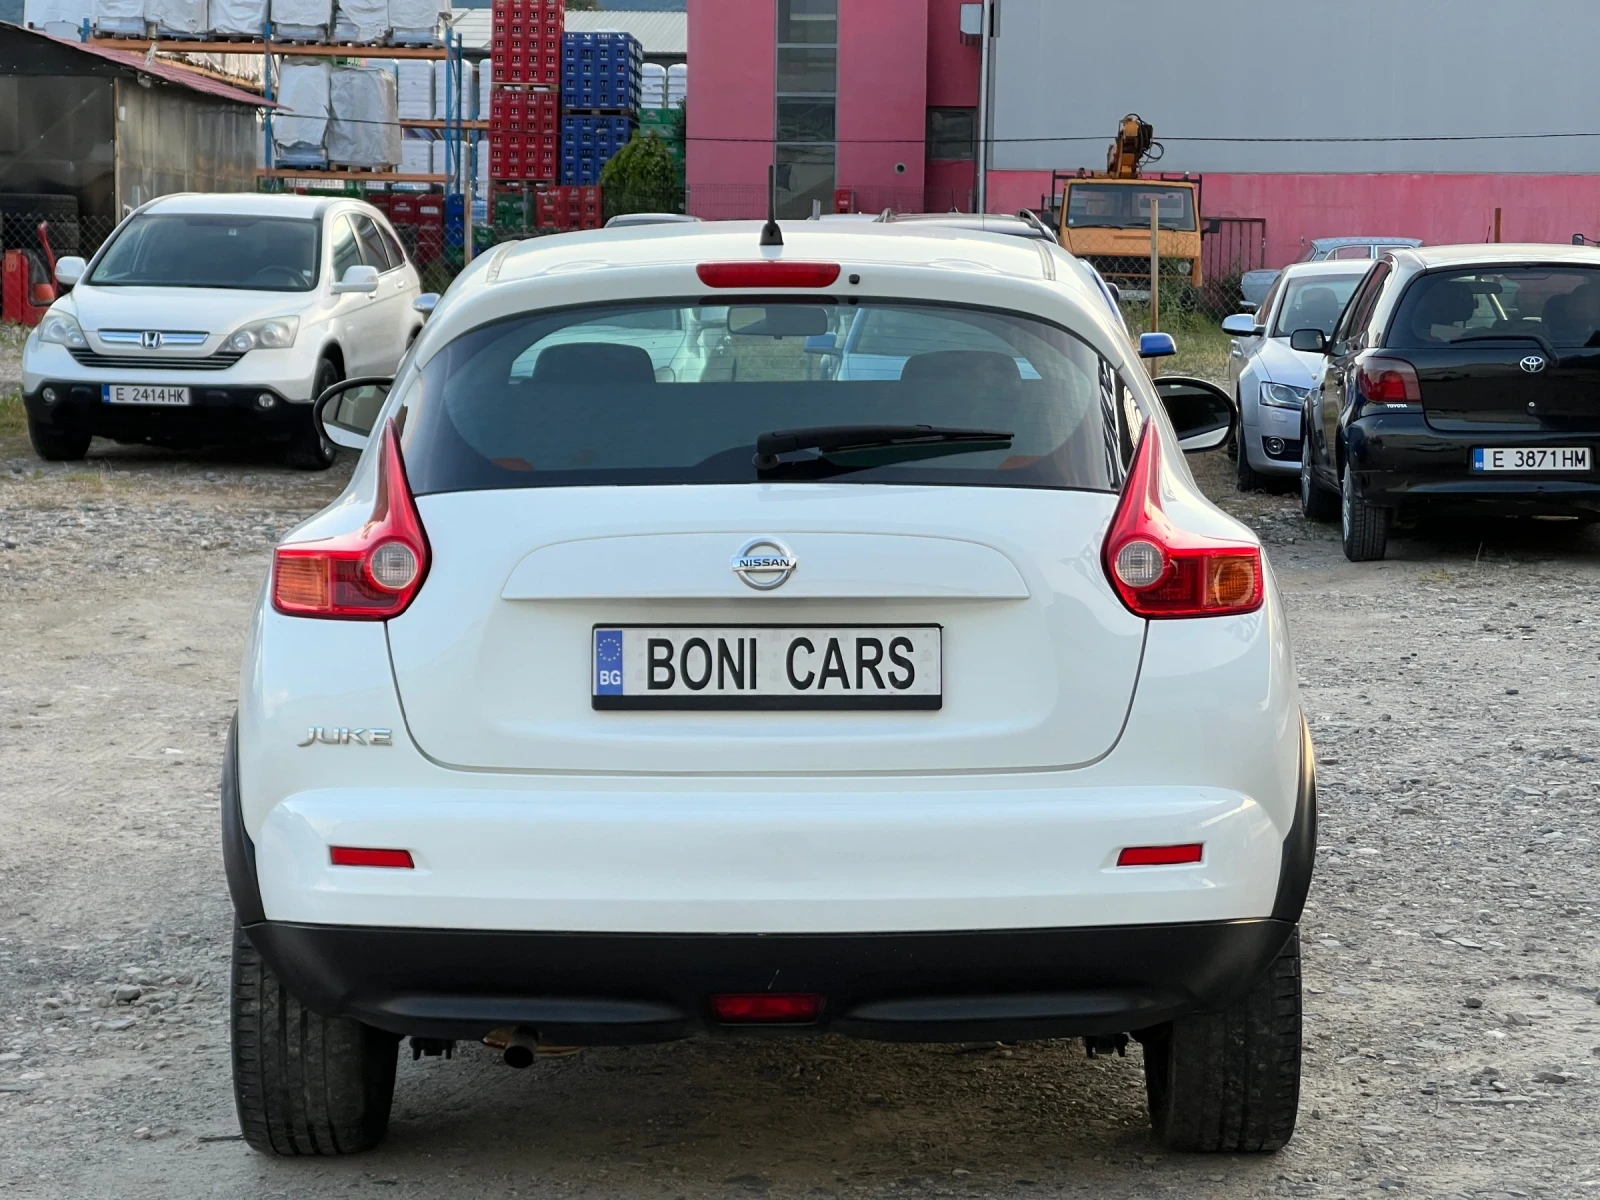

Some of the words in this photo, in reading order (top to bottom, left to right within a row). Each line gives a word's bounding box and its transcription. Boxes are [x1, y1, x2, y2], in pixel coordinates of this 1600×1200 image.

[115, 387, 125, 401] E
[1492, 450, 1504, 468] E
[739, 558, 790, 567] NISSAN
[646, 636, 758, 691] BONI
[785, 636, 917, 691] CARS
[599, 670, 621, 685] BG
[296, 726, 393, 748] JUKE
